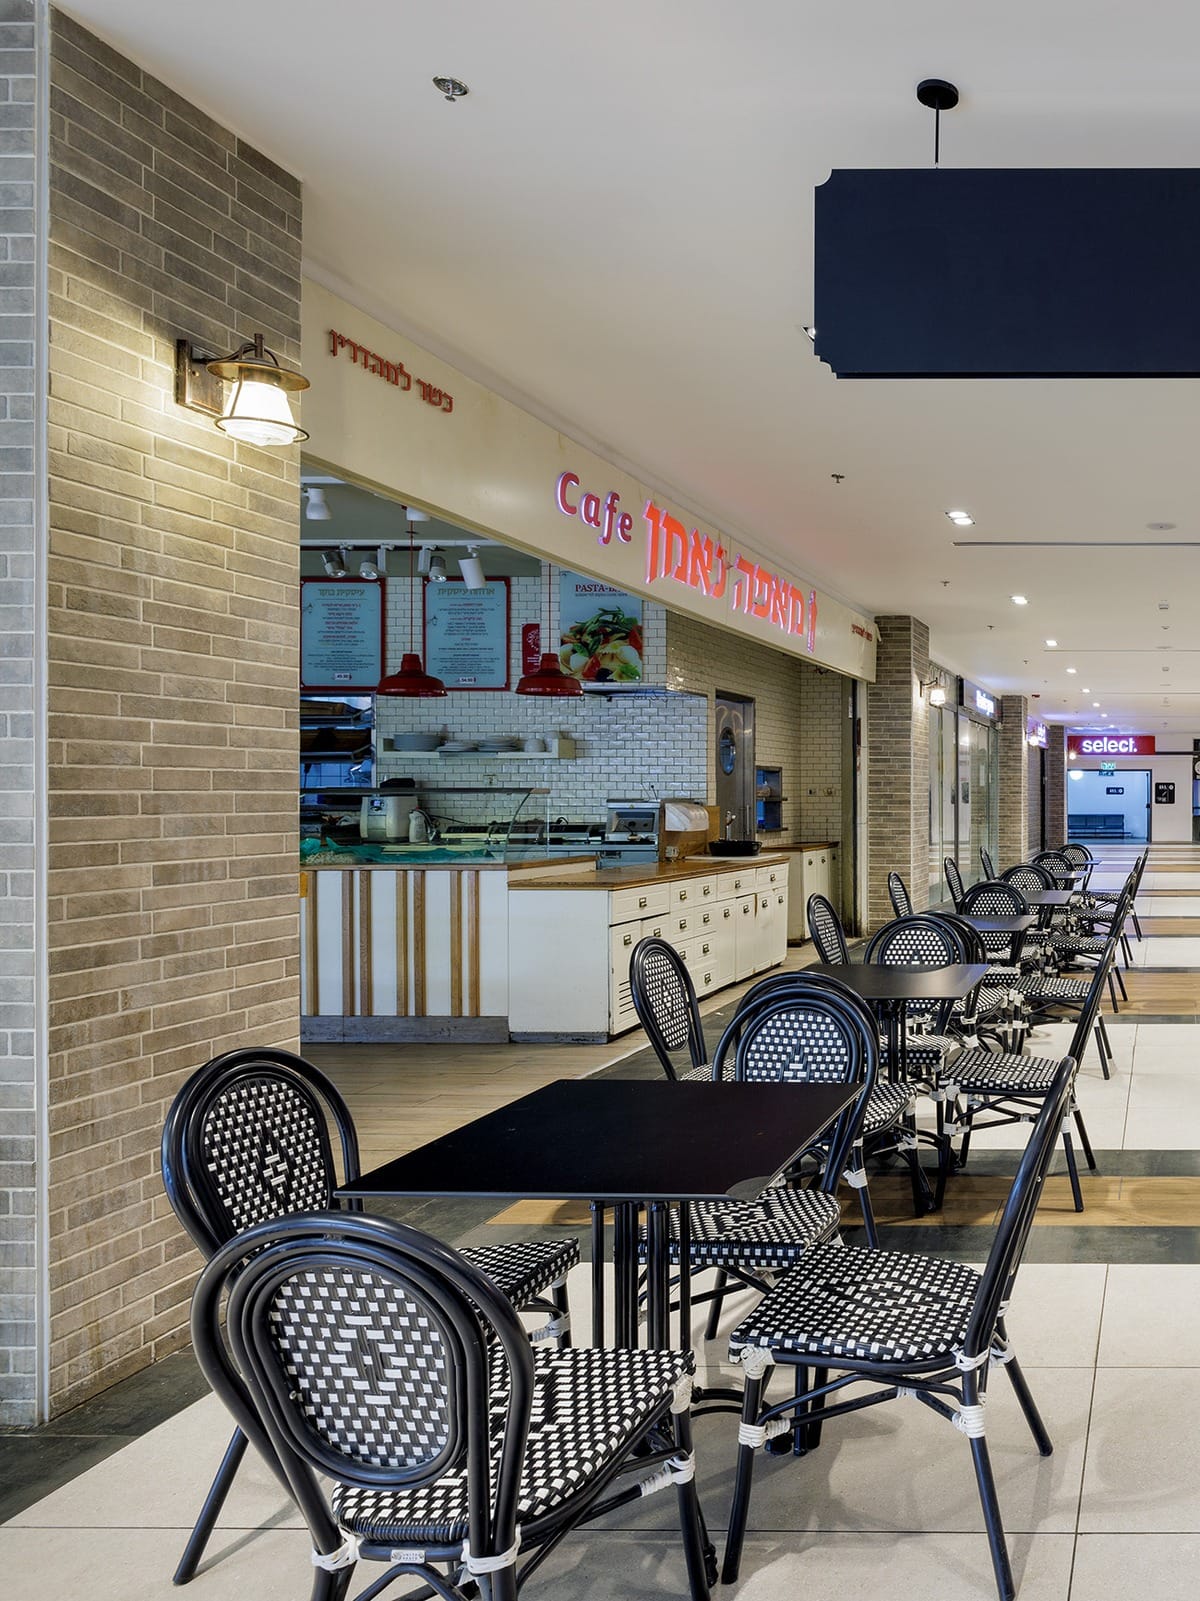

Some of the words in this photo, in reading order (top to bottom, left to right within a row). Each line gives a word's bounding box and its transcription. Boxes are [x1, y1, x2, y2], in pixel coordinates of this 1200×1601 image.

[329, 329, 411, 391] למהדרין
[416, 378, 453, 413] כשר
[556, 471, 633, 545] Cafe
[642, 500, 727, 599] נאמן
[575, 584, 621, 592] PASTA-B
[732, 552, 805, 636] מאפה
